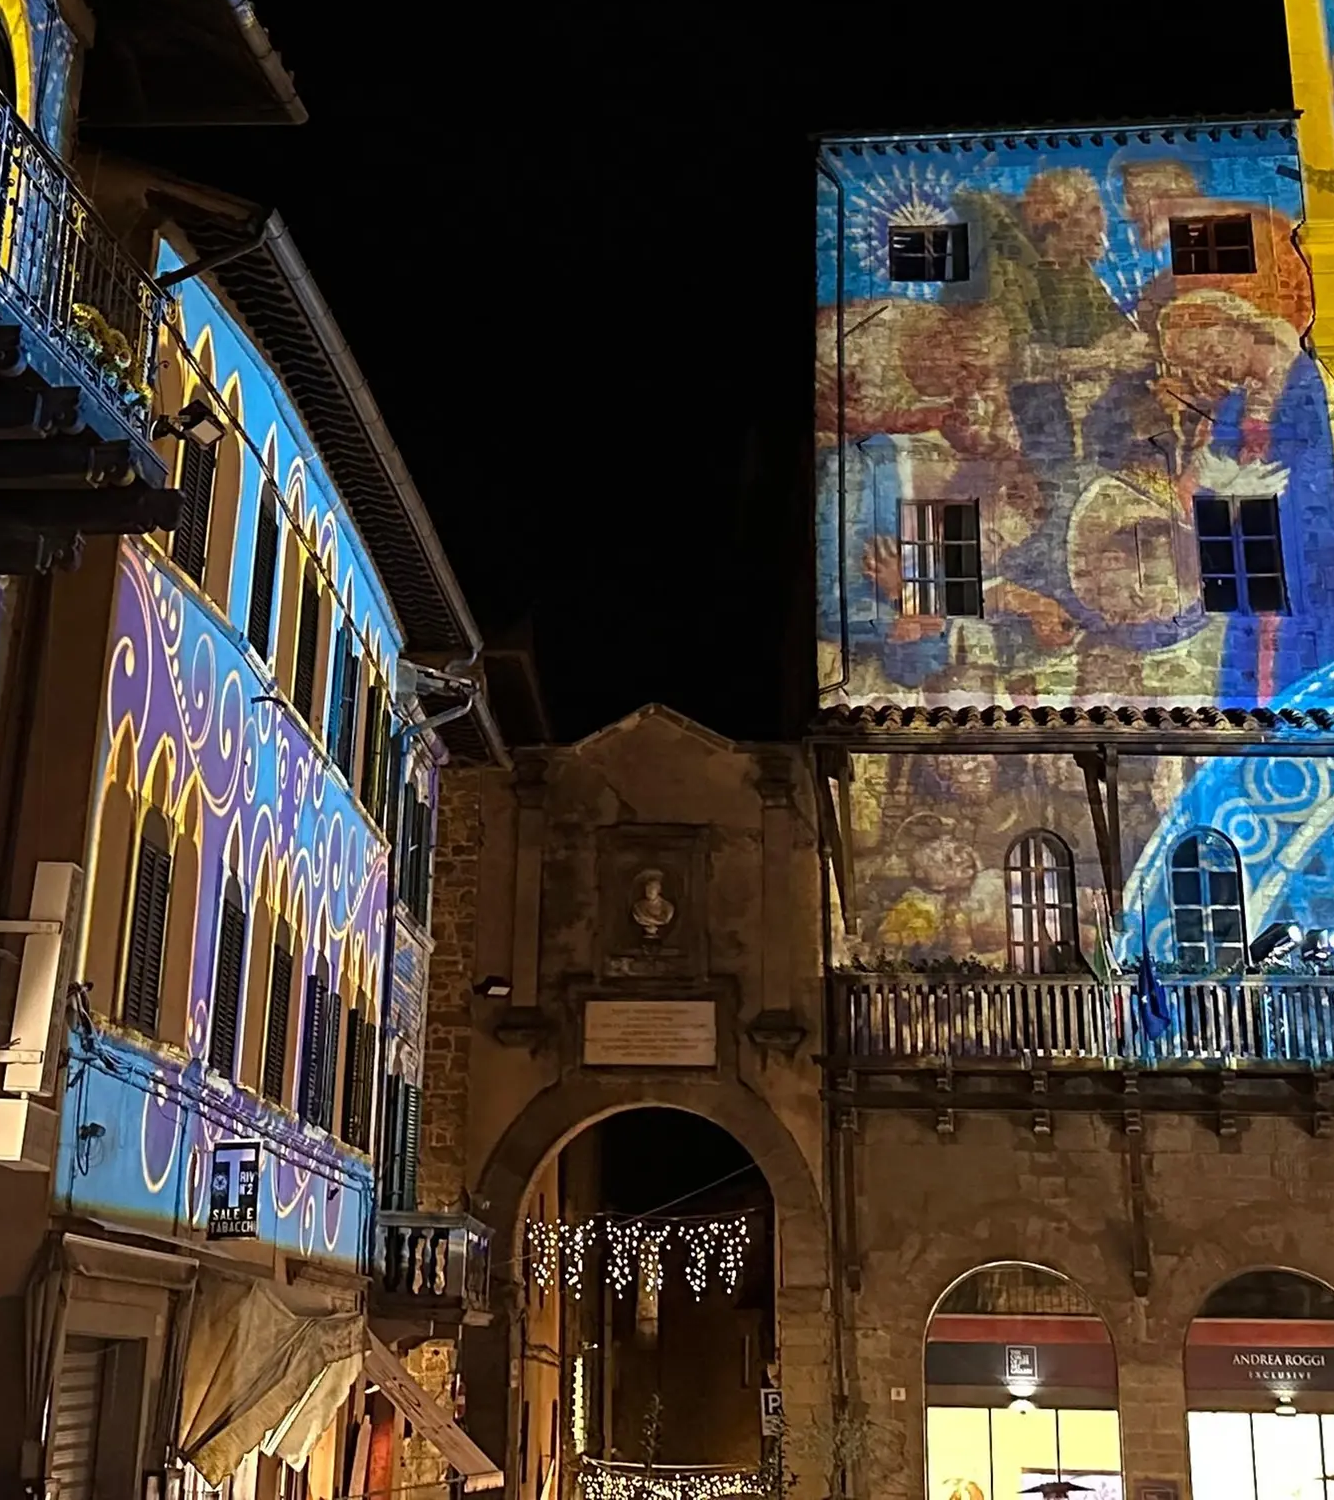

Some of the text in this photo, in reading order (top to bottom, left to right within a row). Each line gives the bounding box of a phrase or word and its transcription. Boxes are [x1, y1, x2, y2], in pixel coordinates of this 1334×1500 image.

[216, 1149, 256, 1208] T
[212, 1207, 254, 1221] SALE E
[1232, 1353, 1326, 1367] ANDREA ROGGI
[1248, 1371, 1312, 1380] EXCLUSIVE
[768, 1394, 782, 1413] P
